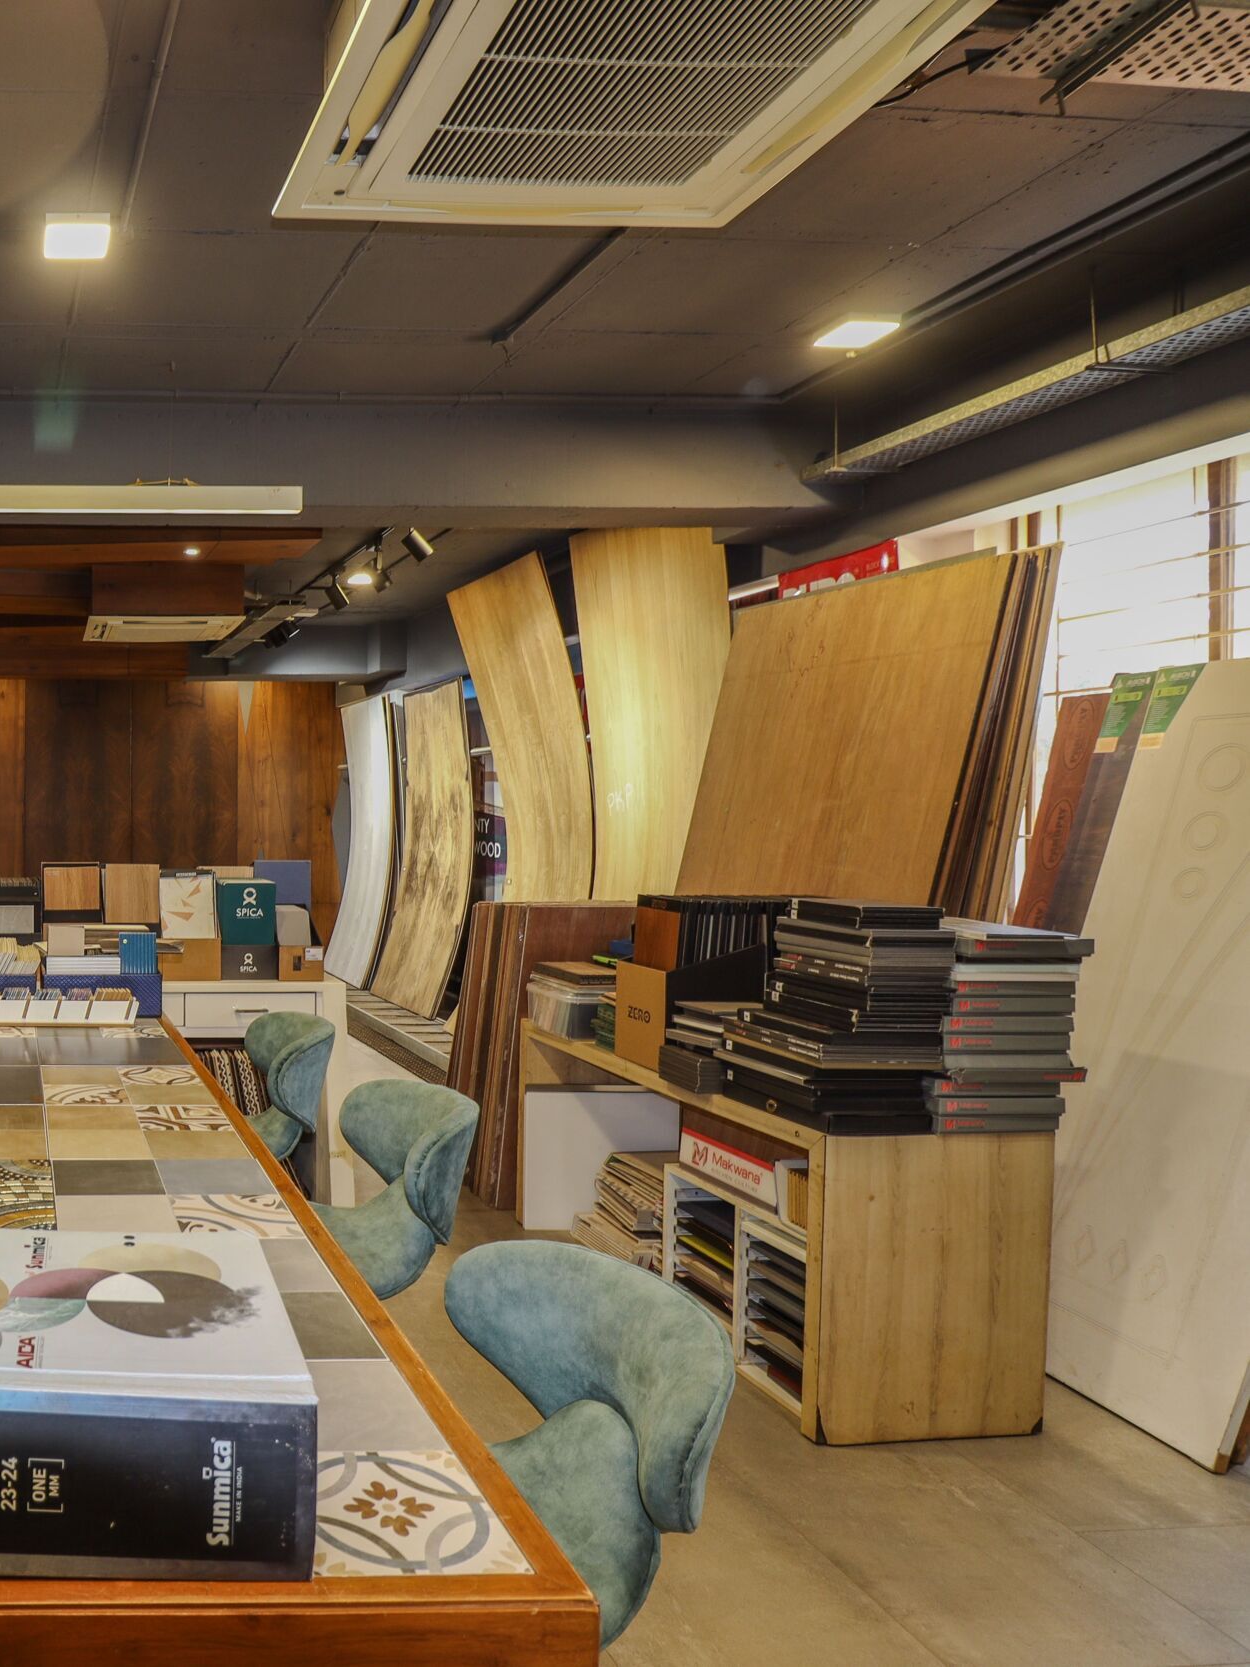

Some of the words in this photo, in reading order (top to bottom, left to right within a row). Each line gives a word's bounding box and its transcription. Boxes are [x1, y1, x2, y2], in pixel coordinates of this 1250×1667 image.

[236, 907, 264, 917] SPICA
[239, 965, 258, 973] SPICA
[627, 1005, 651, 1024] ZERO
[712, 1152, 761, 1186] Makwana
[16, 1336, 36, 1369] AICA
[0, 1456, 19, 1512] 23-24
[32, 1468, 47, 1503] ONE
[48, 1474, 60, 1498] MM
[203, 1440, 233, 1547] Sunmica
[235, 1489, 242, 1500] IN
